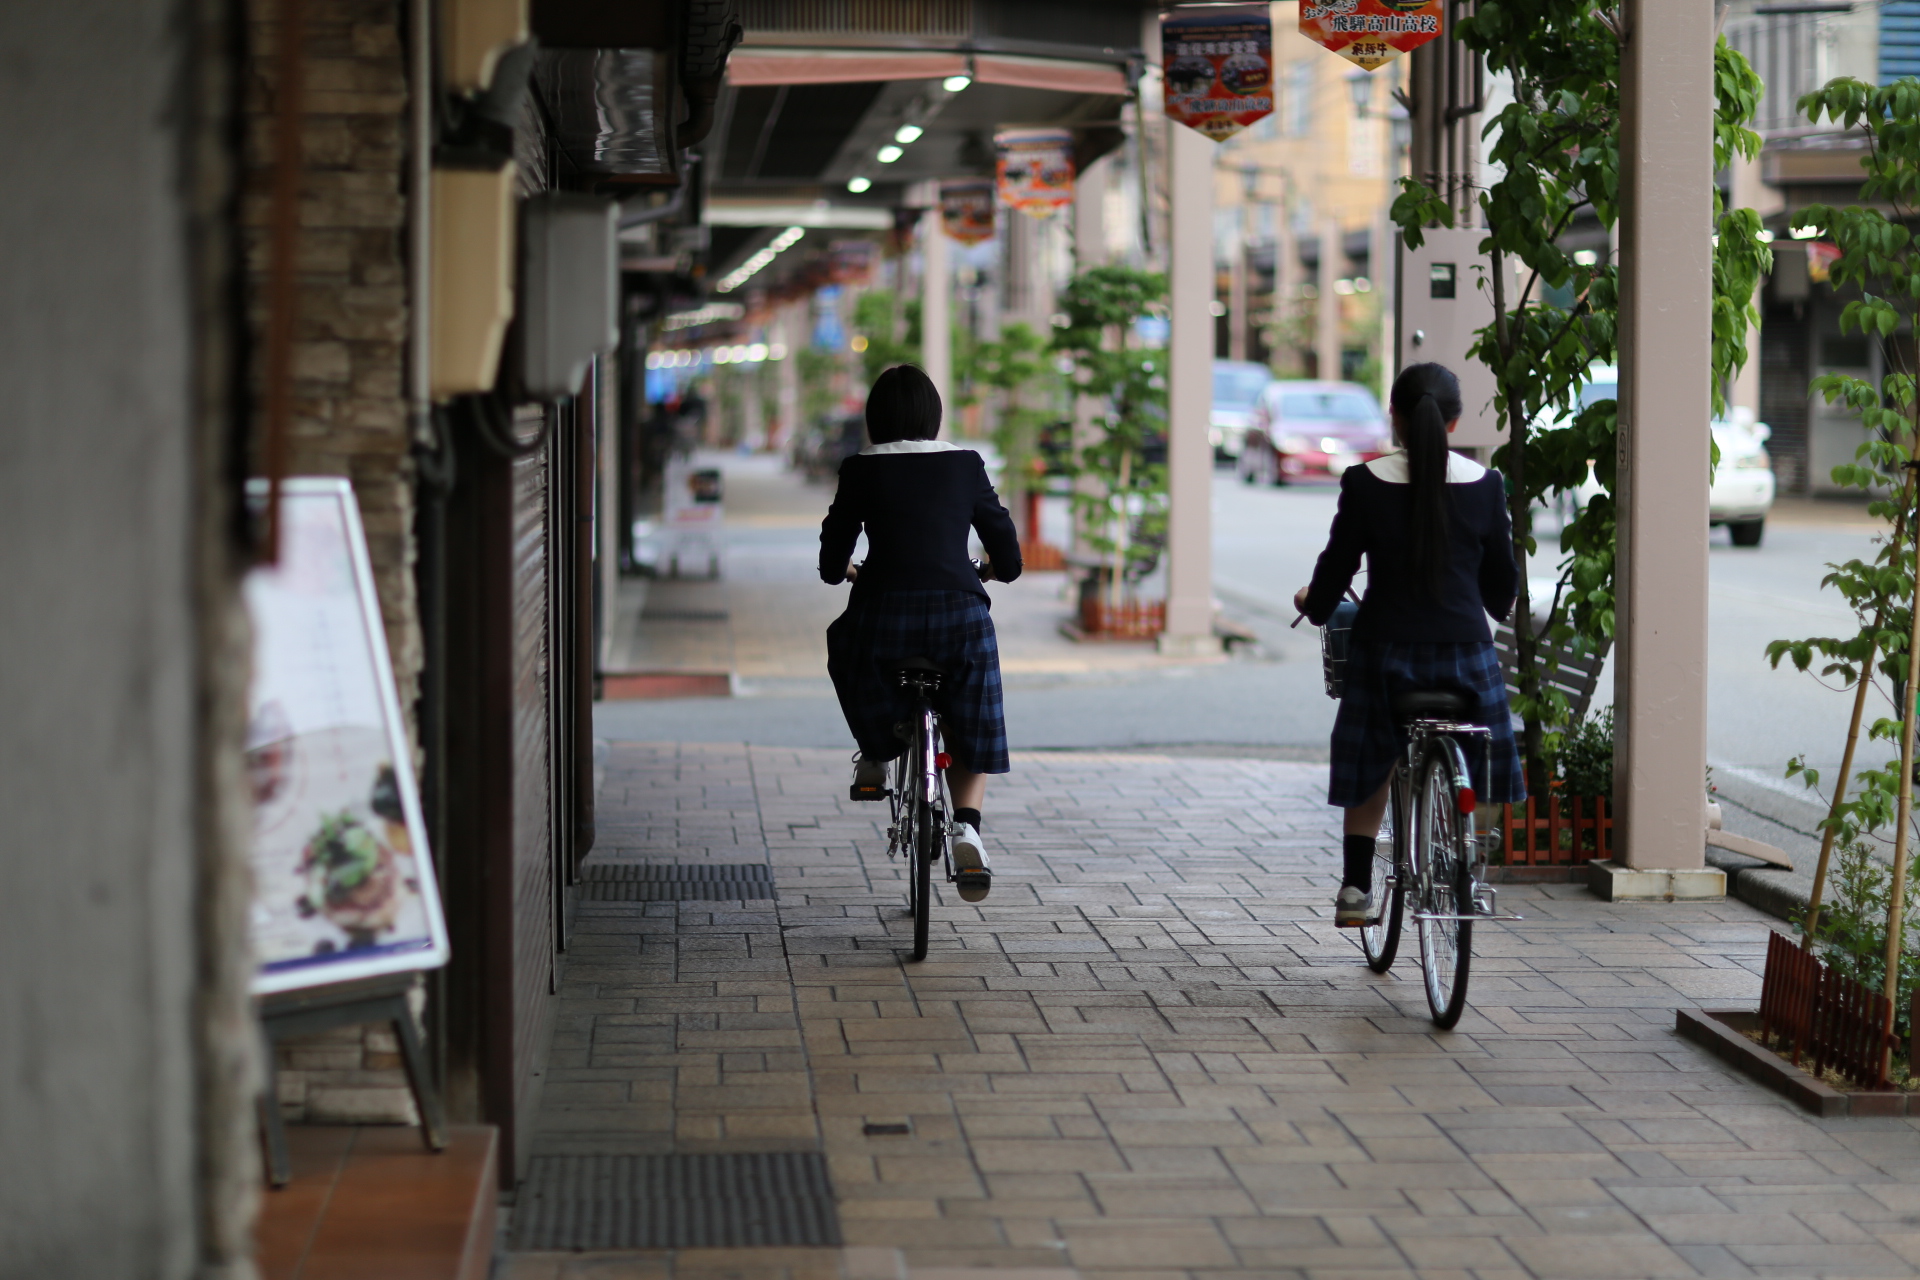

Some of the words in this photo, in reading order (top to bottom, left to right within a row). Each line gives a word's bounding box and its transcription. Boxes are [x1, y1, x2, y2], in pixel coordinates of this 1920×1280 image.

[1304, 0, 1358, 19] おめでとう
[1332, 14, 1437, 32] 飛騨高山高校
[1351, 42, 1388, 56] 飛騨牛
[1358, 57, 1381, 65] 高山市
